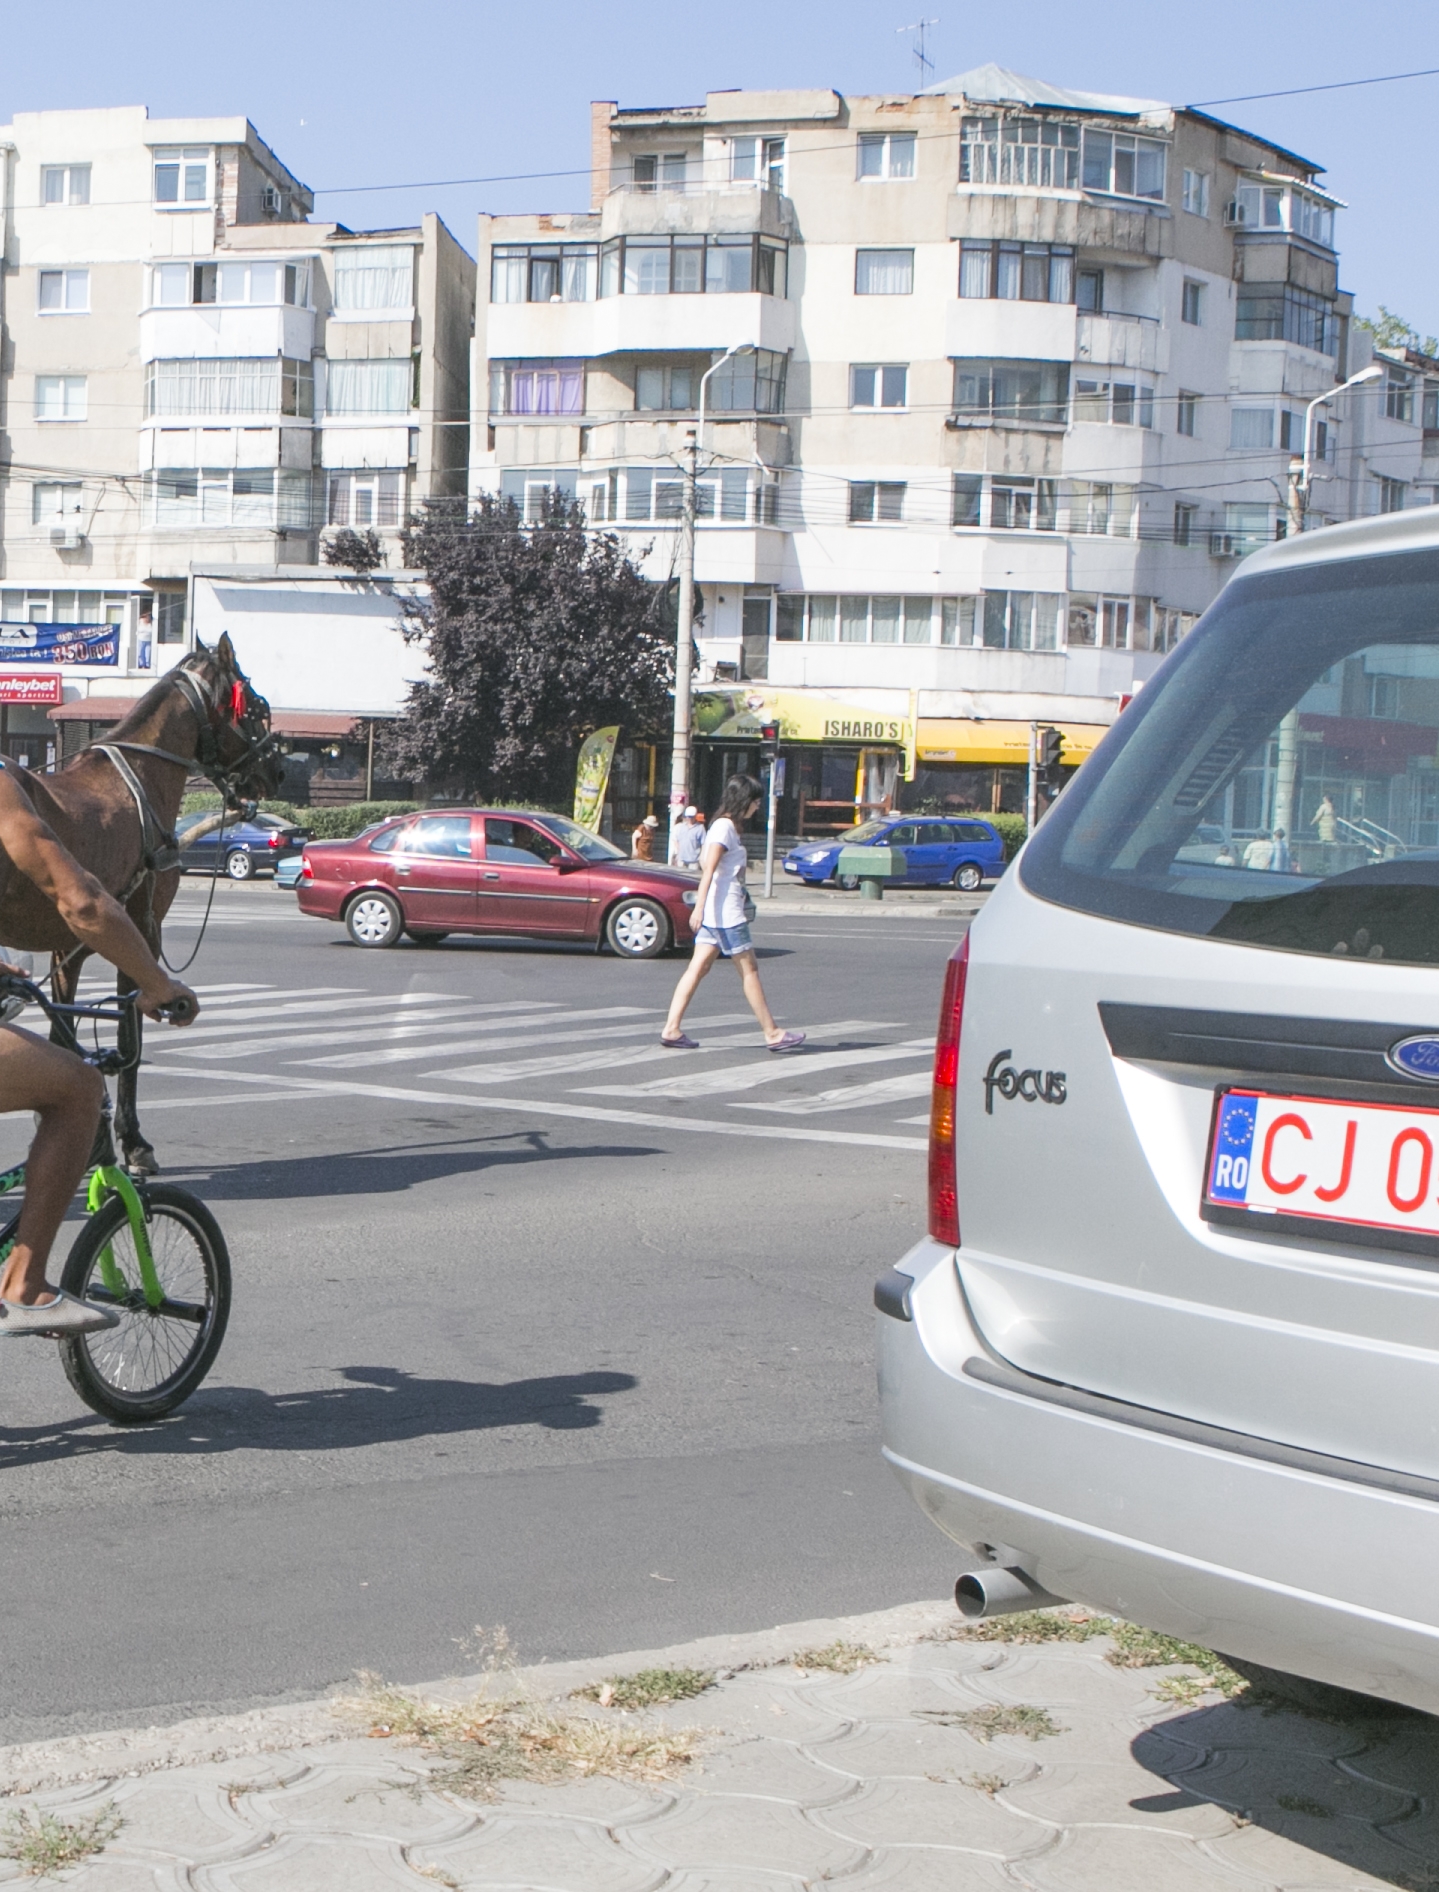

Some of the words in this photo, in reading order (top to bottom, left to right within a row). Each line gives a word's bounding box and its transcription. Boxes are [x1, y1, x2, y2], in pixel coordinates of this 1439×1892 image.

[51, 641, 89, 665] 350
[89, 641, 115, 660] RON
[825, 720, 899, 738] ISHARO'S
[1215, 1153, 1249, 1190] RO
[1261, 1112, 1358, 1203] CJ
